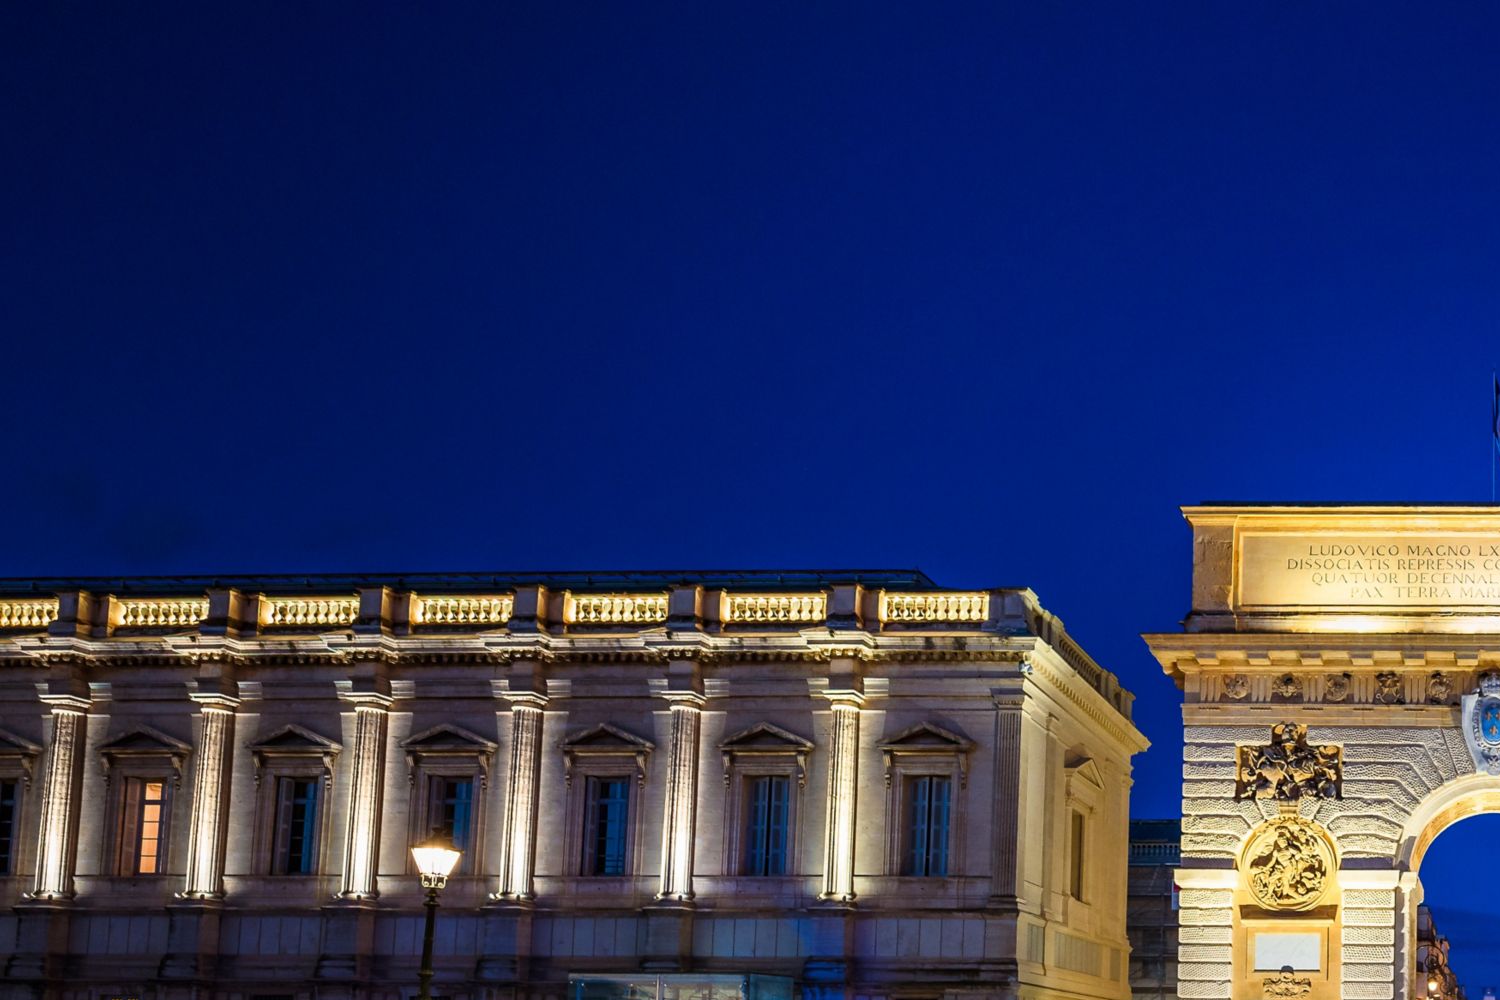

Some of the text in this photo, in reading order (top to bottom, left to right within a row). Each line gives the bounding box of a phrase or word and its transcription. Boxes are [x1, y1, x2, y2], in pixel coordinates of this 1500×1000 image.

[1309, 545, 1400, 557] LUDOVICO
[1407, 545, 1471, 557] MAGNO
[1287, 558, 1390, 570] DISSOCIATIS
[1397, 558, 1475, 570] REPRESSIS
[1312, 572, 1398, 586] QUATUOR
[1351, 586, 1383, 598] PAX
[1393, 586, 1451, 598] TERRA
